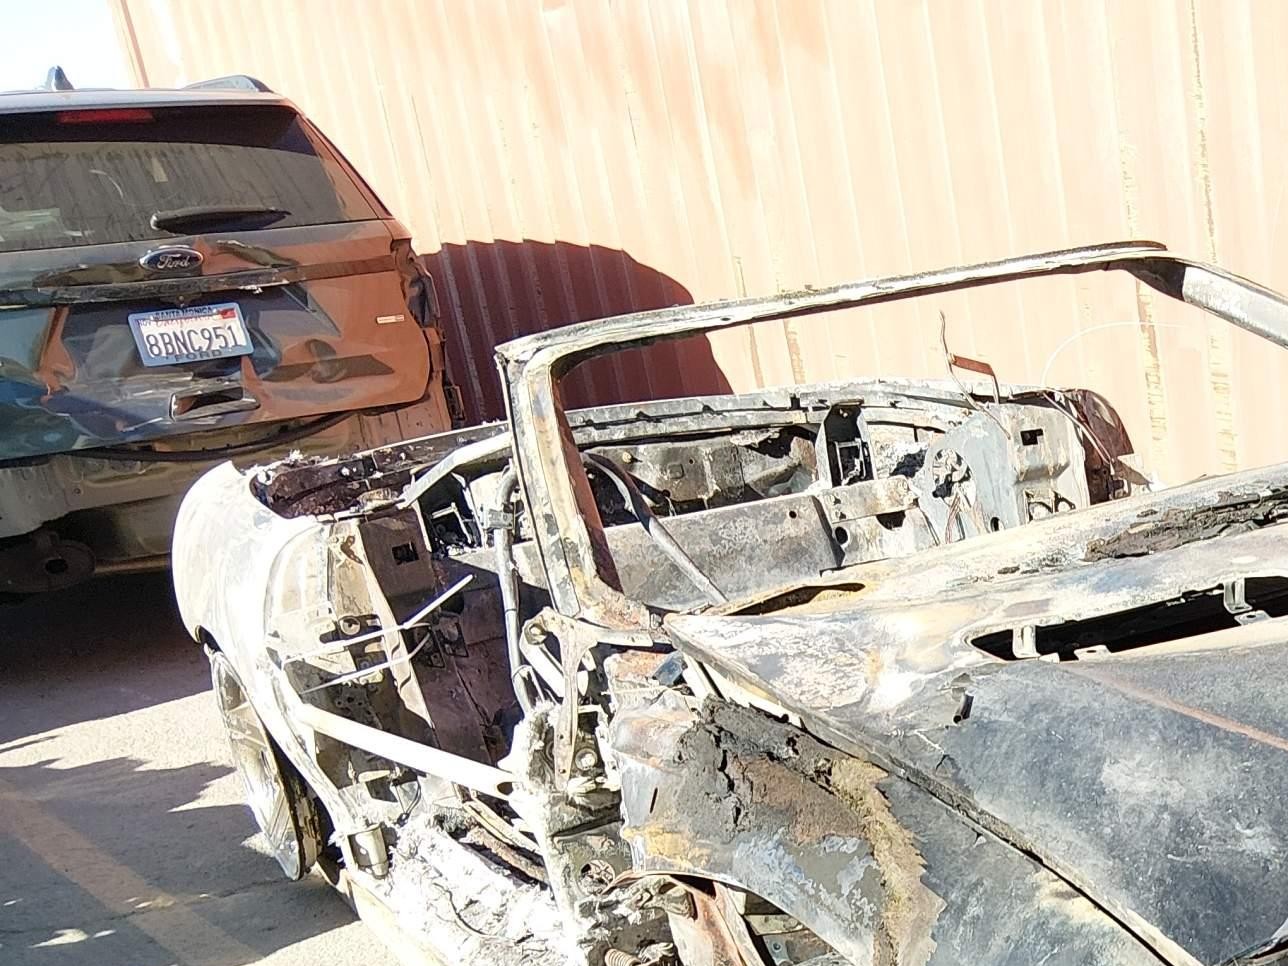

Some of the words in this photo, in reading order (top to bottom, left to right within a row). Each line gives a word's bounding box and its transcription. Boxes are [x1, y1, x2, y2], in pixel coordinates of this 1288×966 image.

[157, 253, 191, 269] Ford
[145, 325, 242, 358] 8BNC951
[175, 349, 222, 362] FORD
